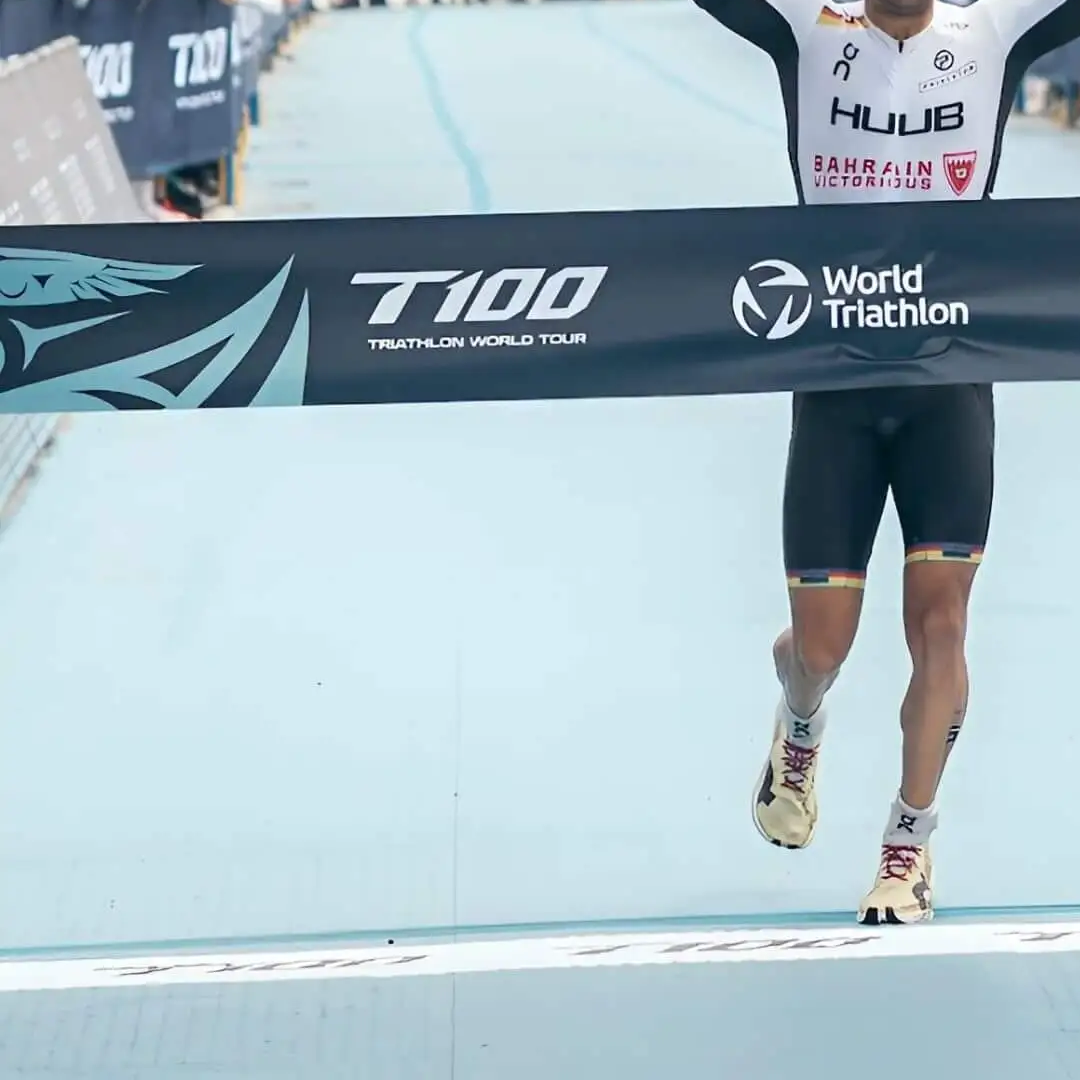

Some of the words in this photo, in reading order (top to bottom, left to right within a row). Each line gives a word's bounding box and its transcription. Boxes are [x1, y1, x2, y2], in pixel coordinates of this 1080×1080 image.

[830, 96, 964, 136] HUUB
[814, 154, 932, 176] BAHRAIN
[350, 266, 608, 324] T100
[822, 264, 923, 295] World
[822, 297, 969, 329] Triathlon
[367, 335, 465, 350] TRIATHLON
[469, 334, 534, 348] WORLD
[538, 332, 587, 345] TOUR
